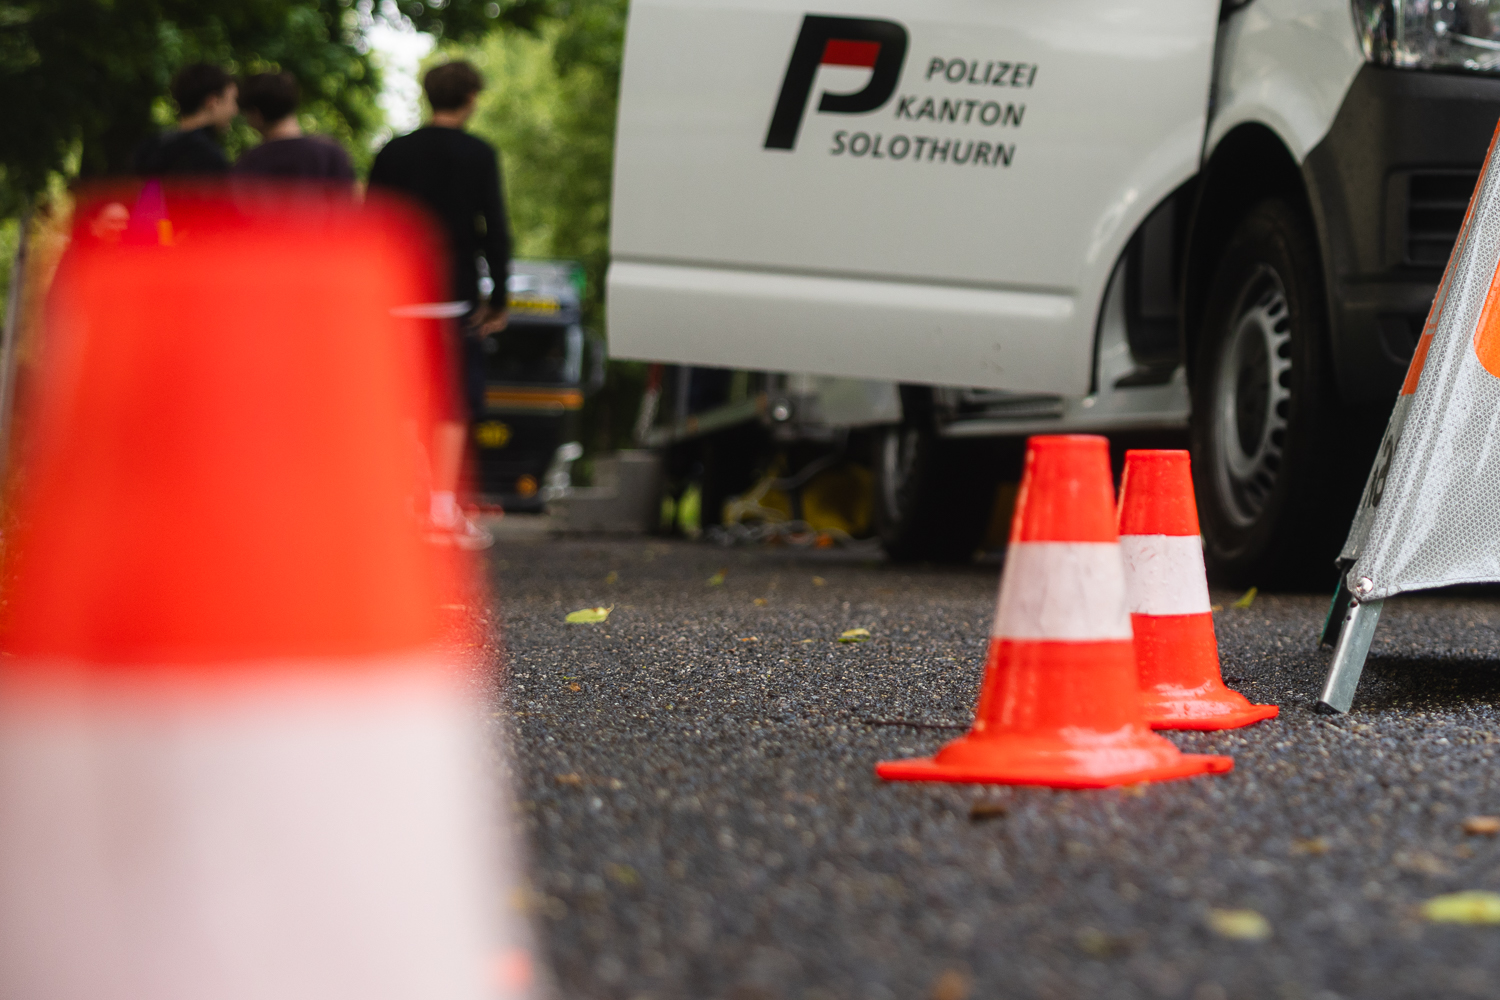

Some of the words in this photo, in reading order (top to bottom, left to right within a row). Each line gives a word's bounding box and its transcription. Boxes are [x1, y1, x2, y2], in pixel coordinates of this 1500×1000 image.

[763, 12, 910, 151] P
[924, 56, 1038, 88] POLIZEI
[894, 95, 1026, 127] KANTON
[828, 130, 1016, 168] SOLOTHURN
